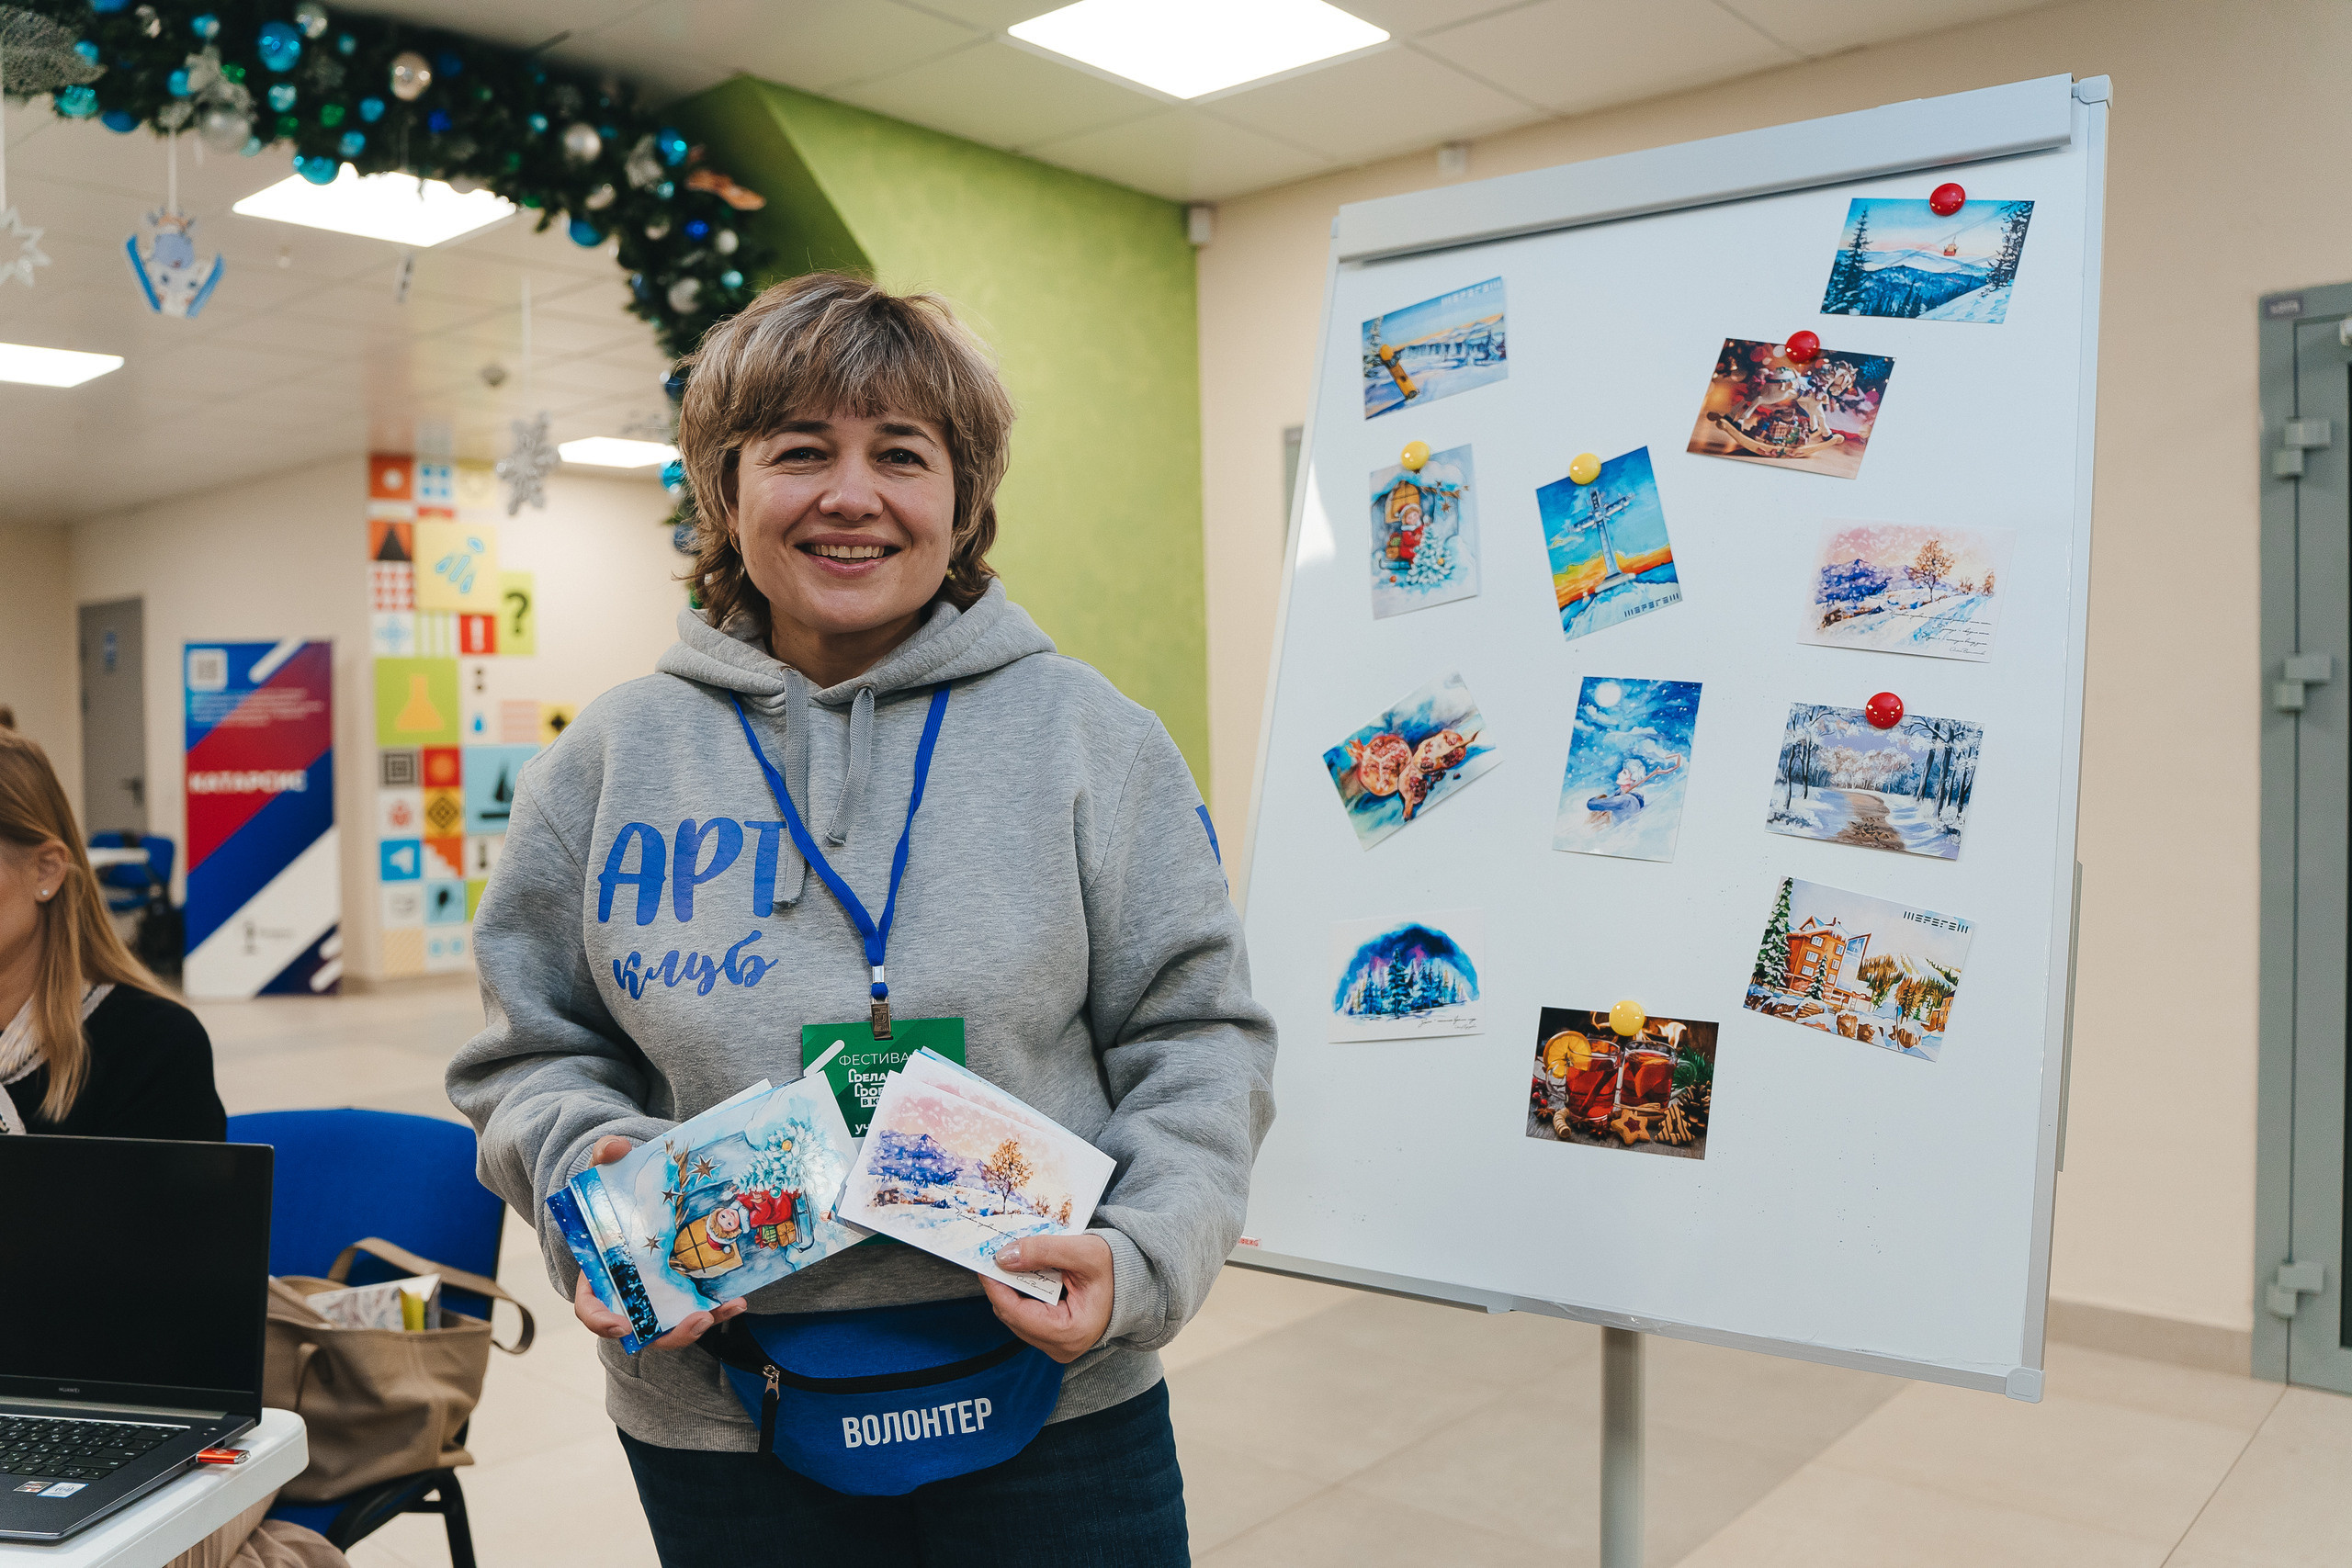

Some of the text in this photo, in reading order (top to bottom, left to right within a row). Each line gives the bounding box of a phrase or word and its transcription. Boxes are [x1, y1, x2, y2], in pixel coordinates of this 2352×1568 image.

[597, 817, 787, 926] АРТ
[612, 930, 779, 1000] клуб
[838, 1052, 910, 1066] ФЕСТИВА
[848, 1068, 887, 1083] СДЕЛА
[842, 1397, 992, 1449] ВОЛОНТЕР
